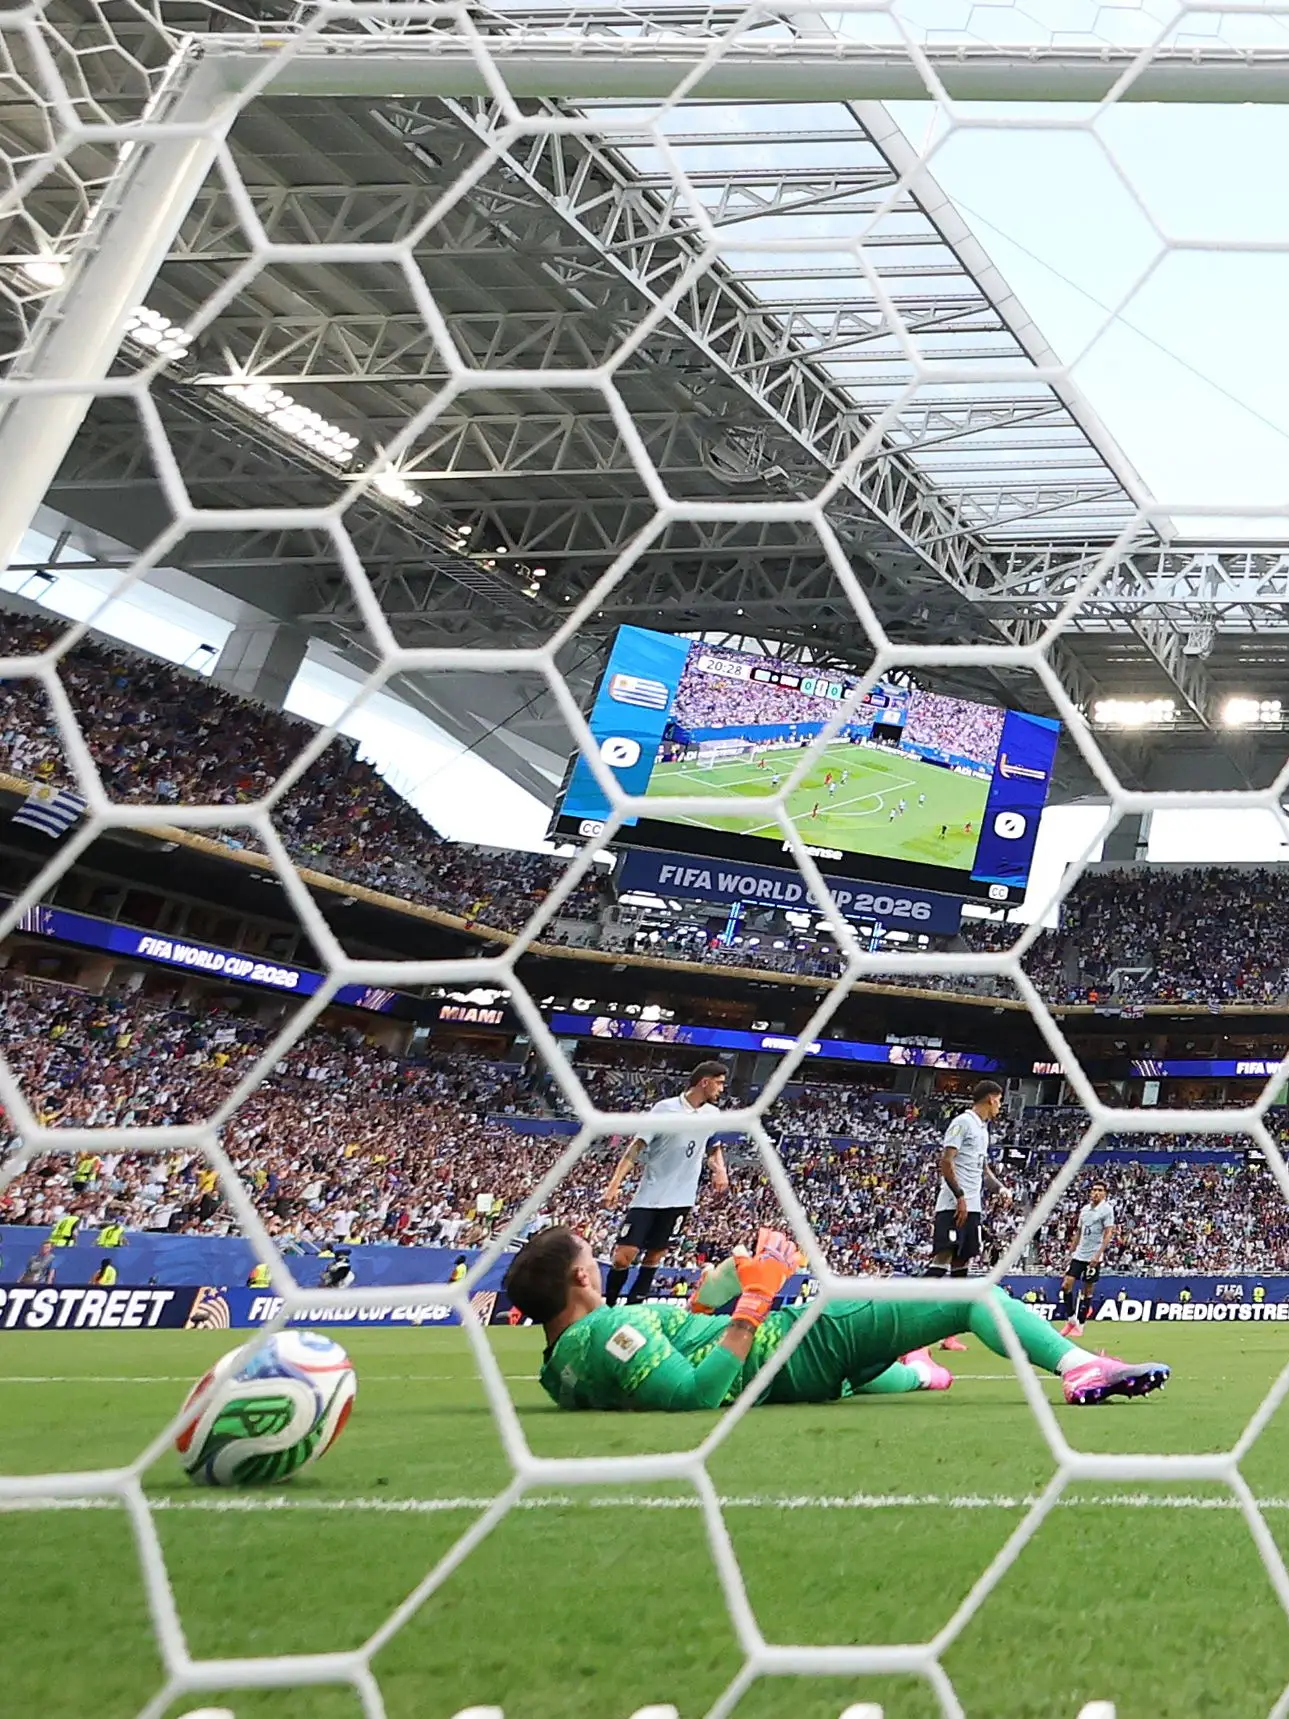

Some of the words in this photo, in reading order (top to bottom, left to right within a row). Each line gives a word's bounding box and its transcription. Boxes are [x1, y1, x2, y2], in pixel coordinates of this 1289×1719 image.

[706, 659, 742, 676] 20:28
[582, 823, 602, 835] CC
[782, 840, 843, 861] Hense
[659, 865, 712, 890] FIFA
[717, 872, 802, 902] WORLD
[853, 893, 932, 920] 2026
[991, 886, 1006, 898] CC
[137, 936, 173, 958] FIFA
[171, 944, 226, 970] WORLD
[224, 957, 254, 976] CUP
[251, 963, 299, 988] 2026
[439, 1005, 505, 1025] MIAMI
[1236, 1062, 1265, 1075] FIFA
[685, 1140, 696, 1158] 8
[673, 1214, 684, 1235] 8
[1215, 1284, 1244, 1298] FIFA
[249, 1296, 290, 1320] FIF
[1095, 1299, 1152, 1321] ADI
